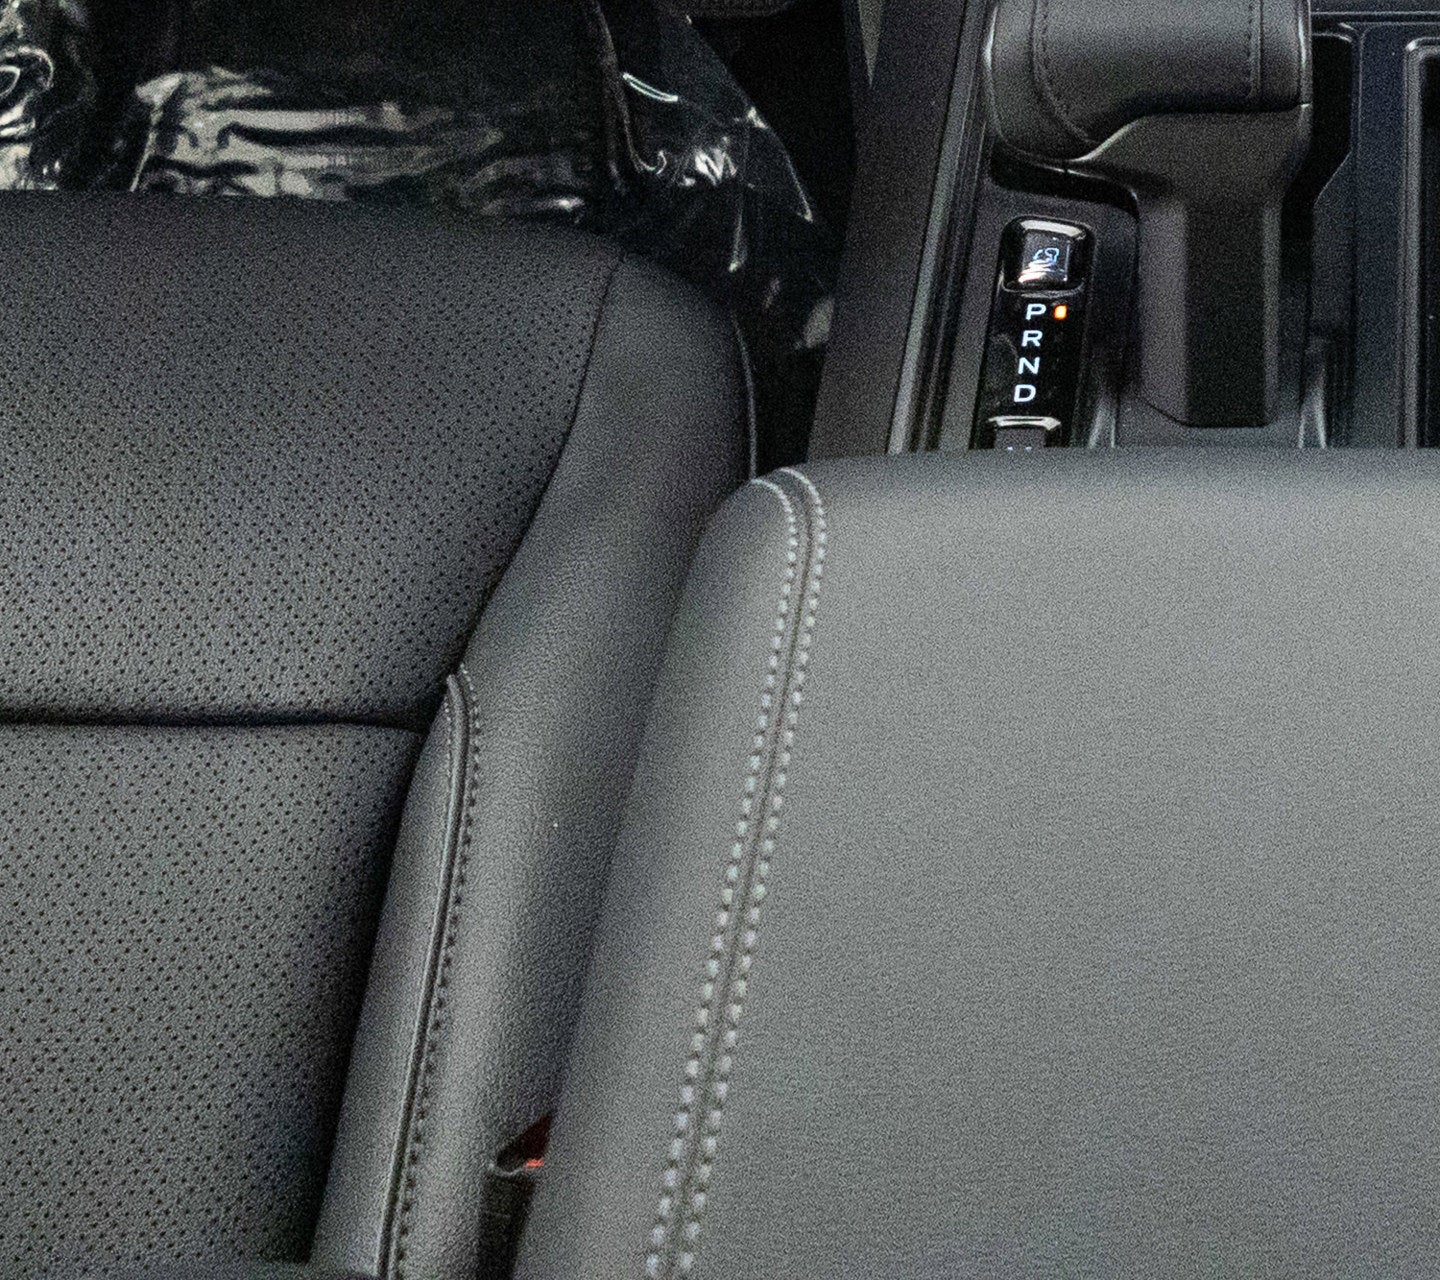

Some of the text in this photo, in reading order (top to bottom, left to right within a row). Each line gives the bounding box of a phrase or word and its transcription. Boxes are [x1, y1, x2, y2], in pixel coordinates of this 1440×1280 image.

[1026, 303, 1046, 320] P
[1021, 329, 1043, 347] R
[1018, 356, 1040, 375] N
[1013, 384, 1036, 403] D
